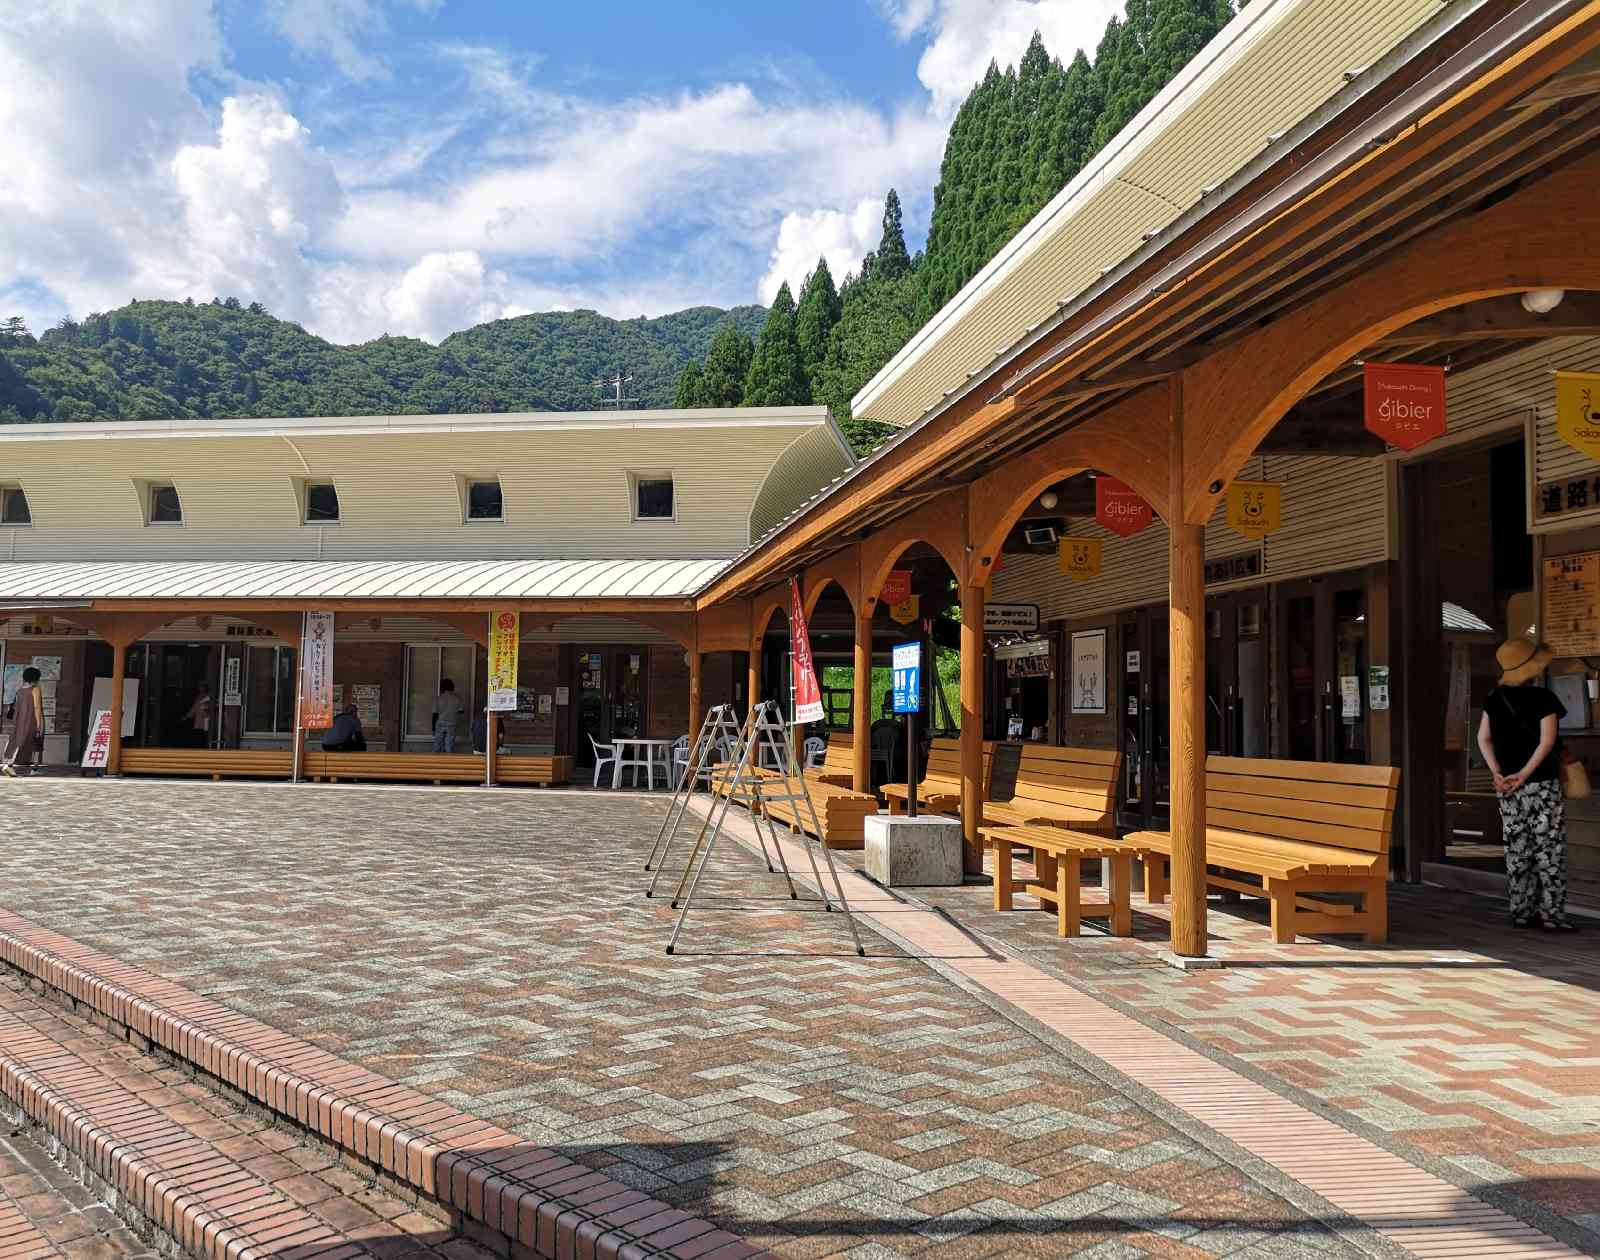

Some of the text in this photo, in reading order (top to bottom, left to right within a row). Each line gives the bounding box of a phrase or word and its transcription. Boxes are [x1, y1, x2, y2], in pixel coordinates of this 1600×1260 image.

[1378, 396, 1433, 422] gibier
[87, 712, 113, 765] 営業中
